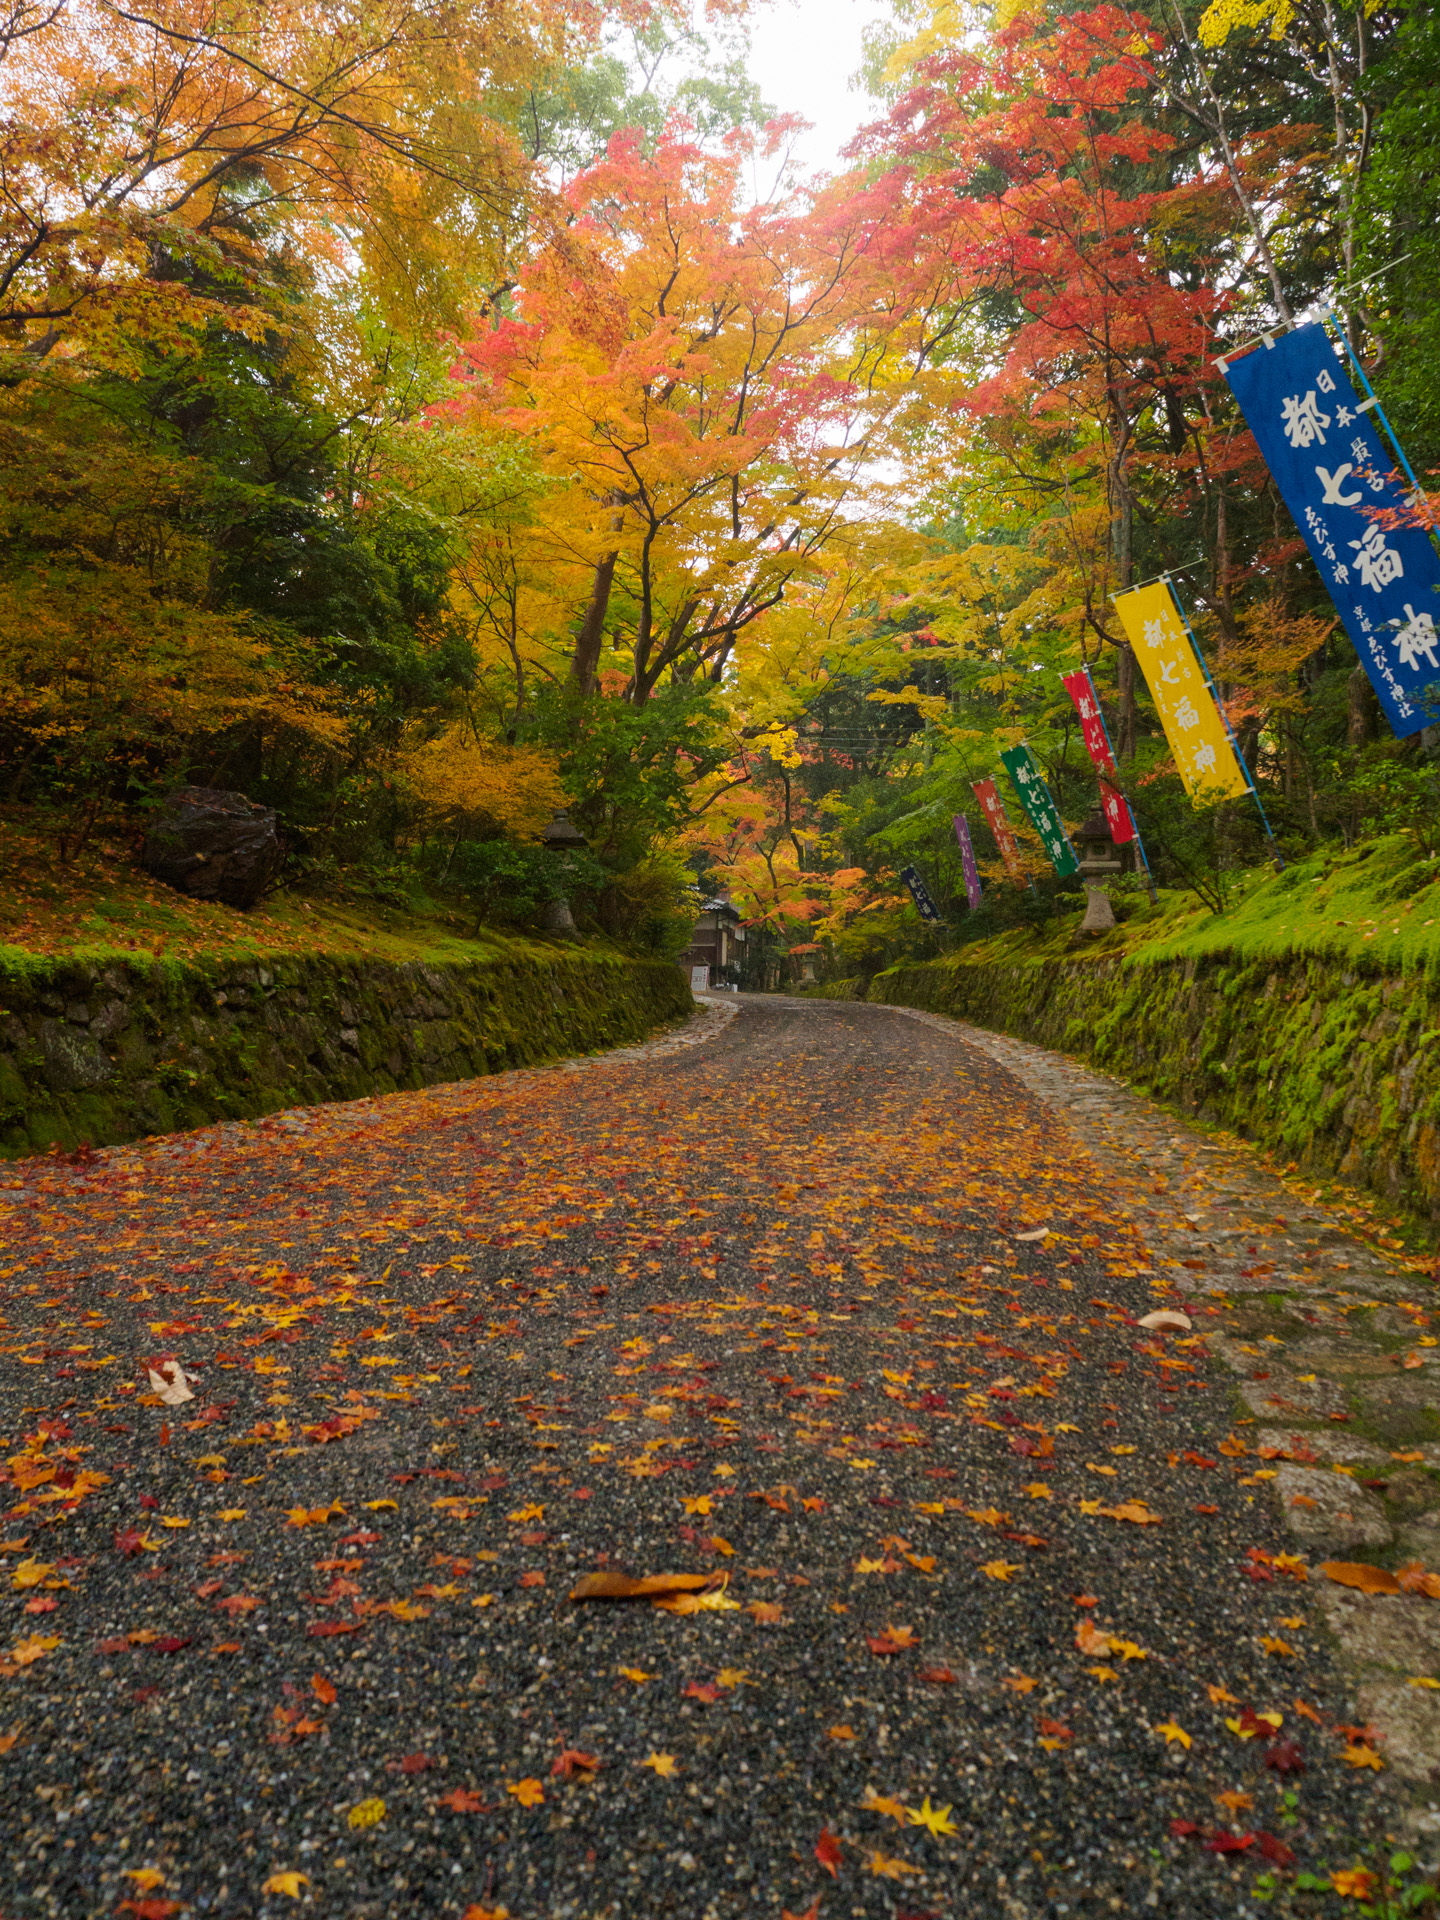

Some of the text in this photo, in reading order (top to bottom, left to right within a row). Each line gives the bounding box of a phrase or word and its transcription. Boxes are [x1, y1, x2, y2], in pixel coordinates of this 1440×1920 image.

[1316, 369, 1385, 492] 日本最古
[1280, 390, 1439, 671] 都七福神
[1143, 619, 1216, 774] 都七福神
